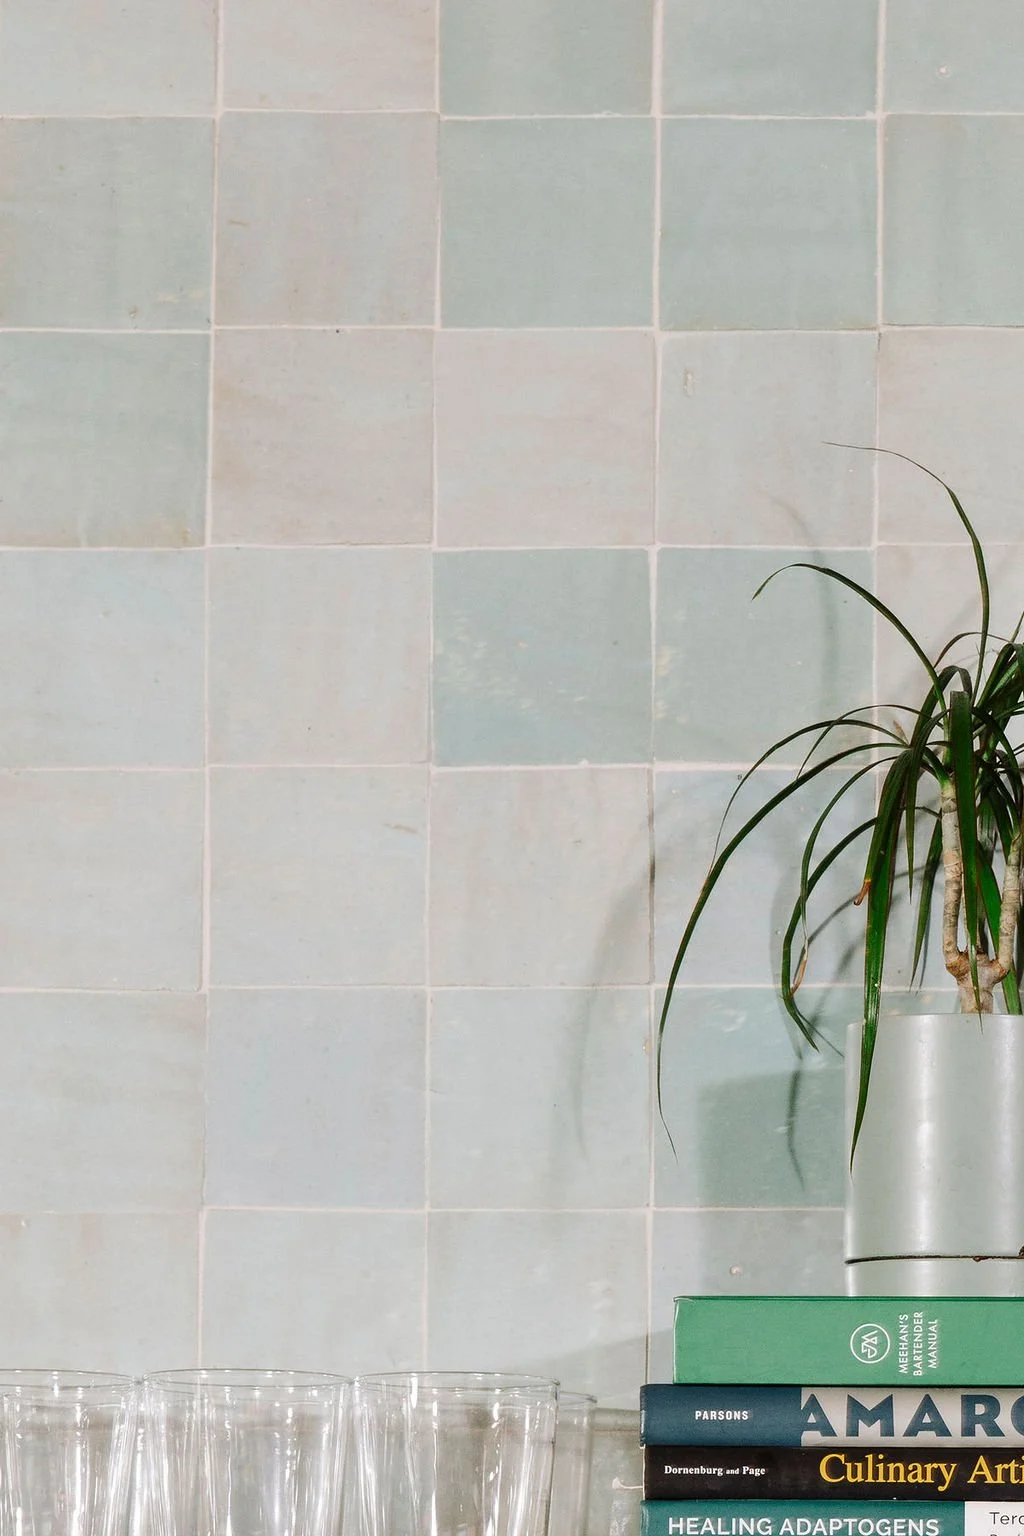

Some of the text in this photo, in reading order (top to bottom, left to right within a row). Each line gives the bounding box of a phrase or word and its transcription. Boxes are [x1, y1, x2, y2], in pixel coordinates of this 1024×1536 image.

[899, 1314, 908, 1374] MEEHAN'S
[913, 1312, 923, 1376] BARTENDER
[928, 1319, 938, 1368] MANUAL
[695, 1410, 749, 1421] PARSONS
[664, 1465, 723, 1479] Dornenburg
[742, 1466, 765, 1479] Page
[818, 1453, 956, 1493] Culinary
[668, 1517, 940, 1536] HEALING ADAPTOGENS
